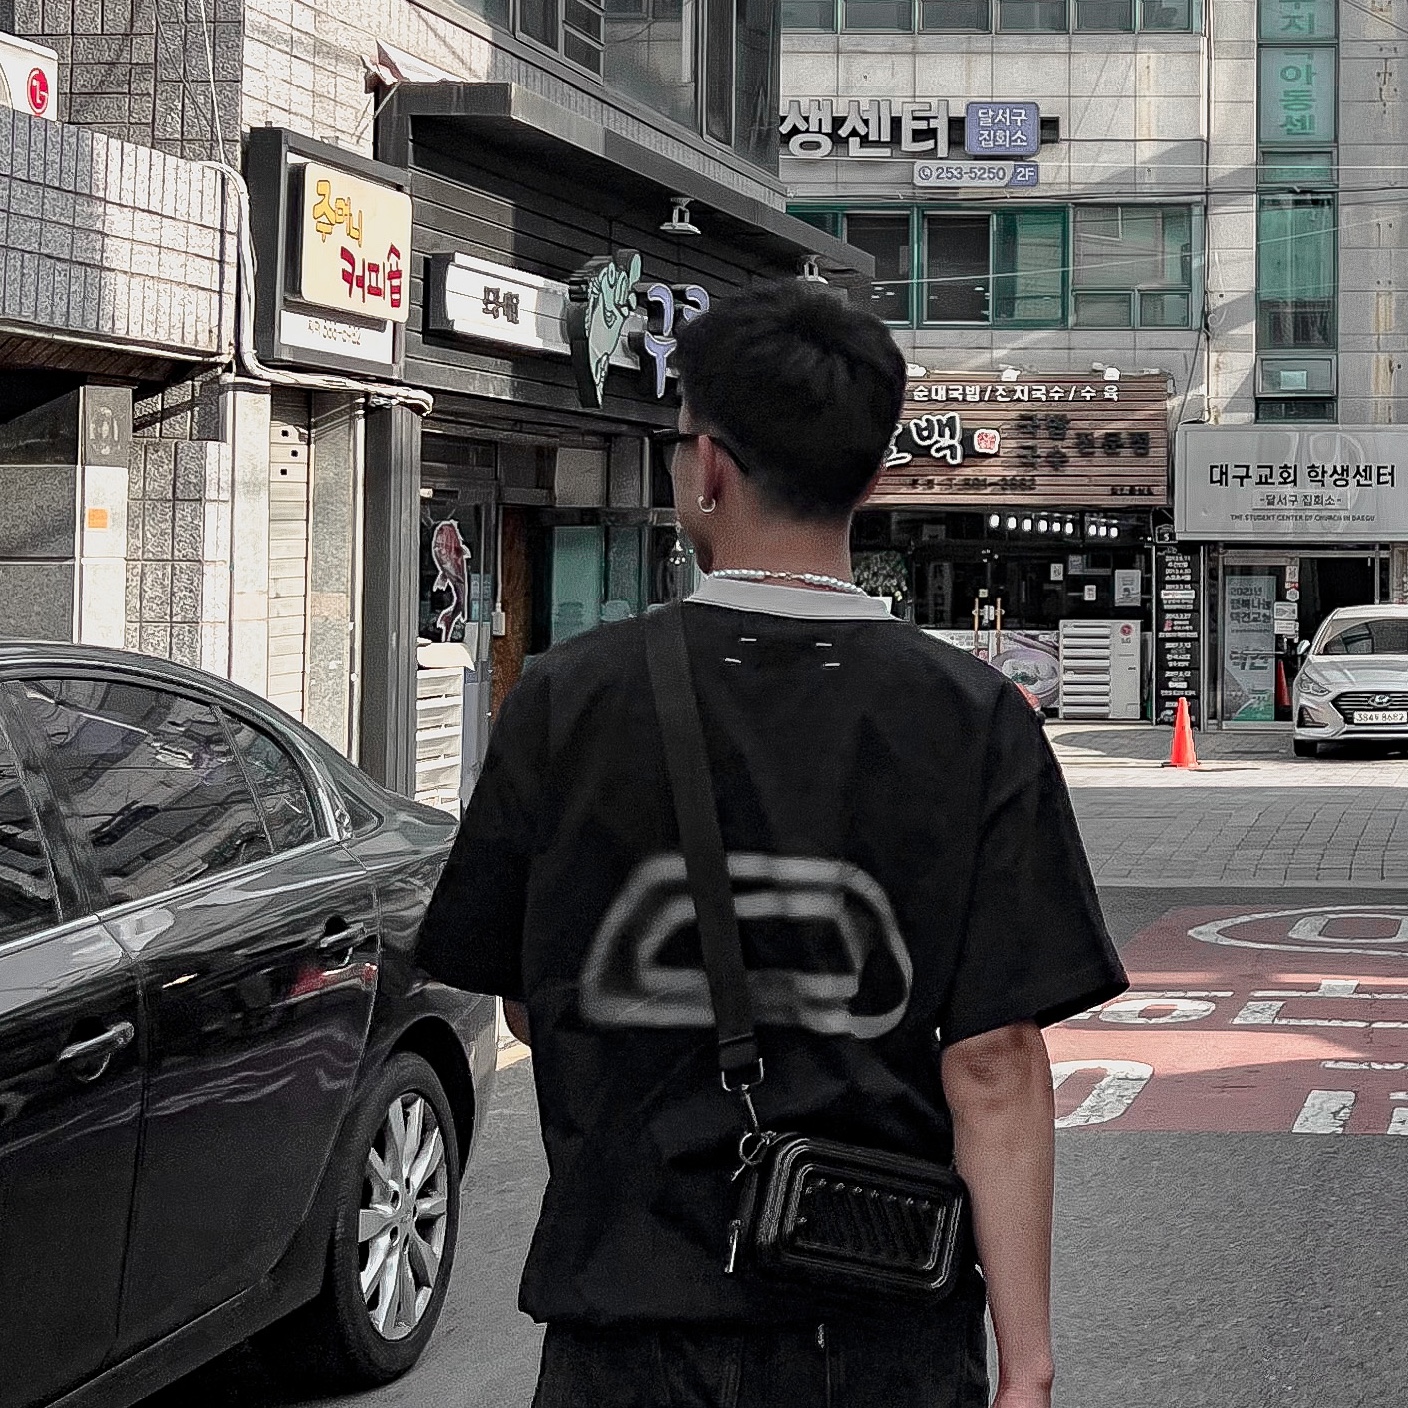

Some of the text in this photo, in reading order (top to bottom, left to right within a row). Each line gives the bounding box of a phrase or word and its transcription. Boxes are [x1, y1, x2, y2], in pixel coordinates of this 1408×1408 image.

[978, 108, 1029, 127] 달서구
[978, 130, 1029, 148] 집회소
[935, 166, 1006, 181] 253-5250
[1016, 166, 1036, 181] 2F
[313, 180, 363, 248] 주머니
[1209, 463, 1396, 488] 대구교회 학생센터
